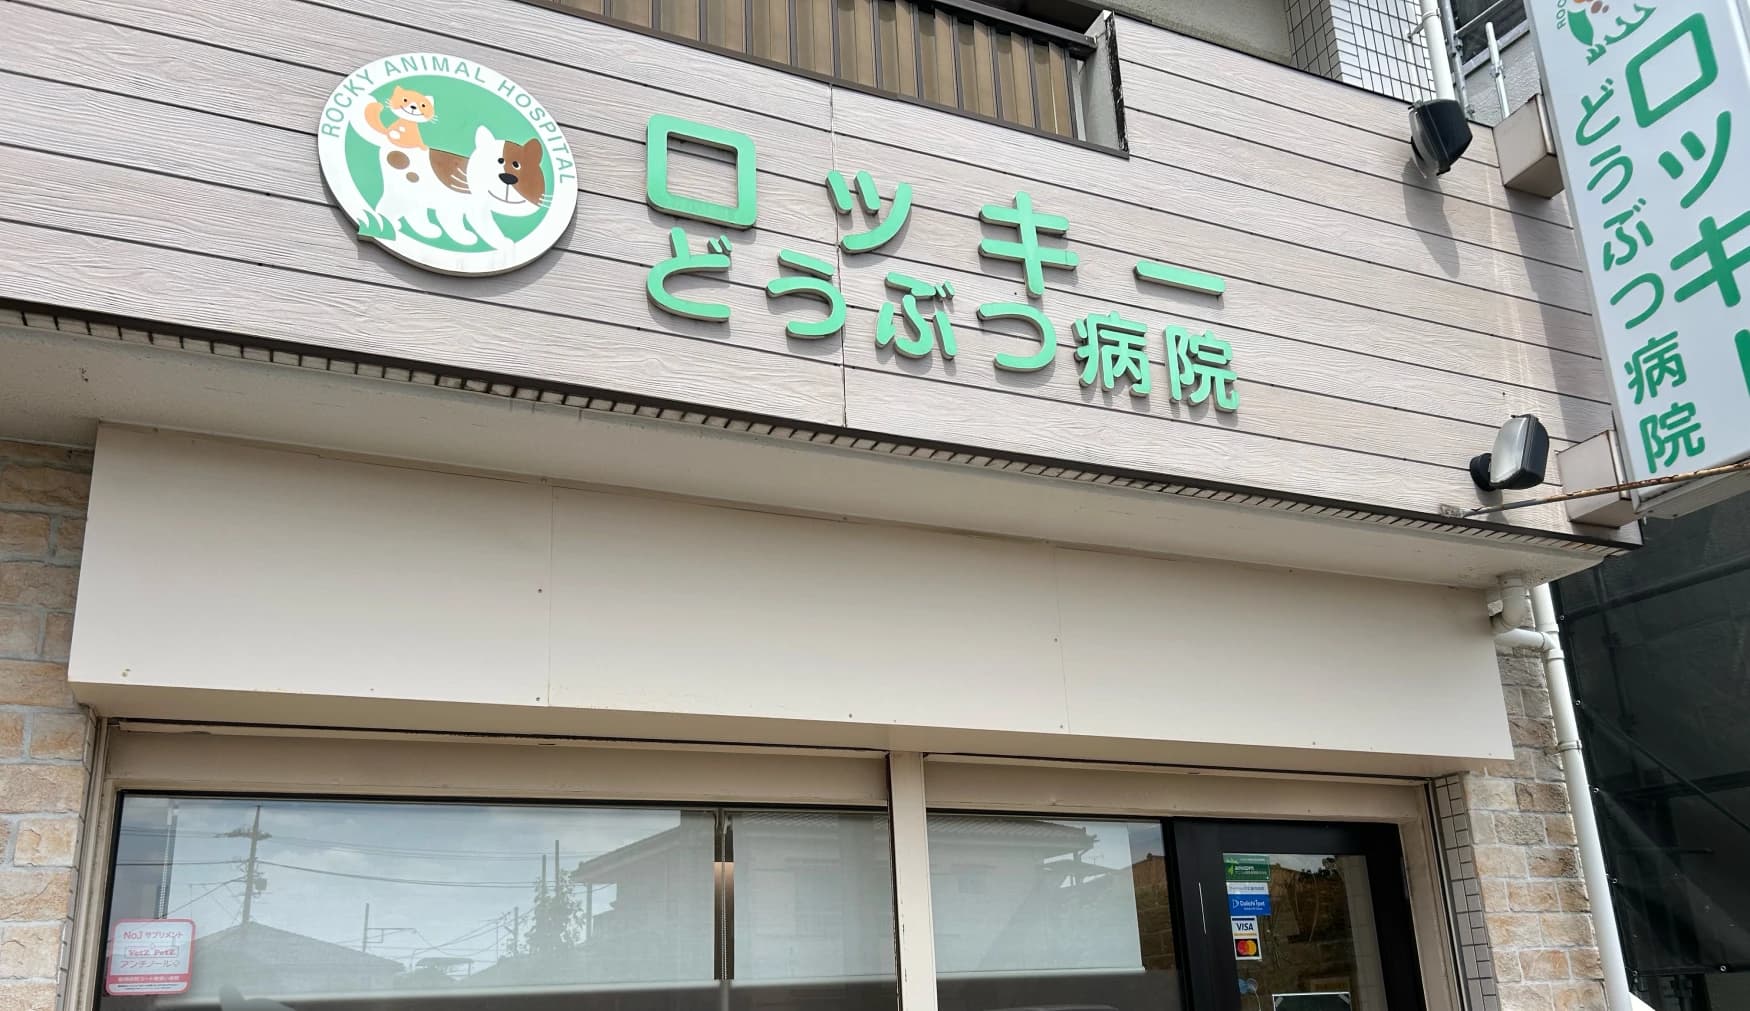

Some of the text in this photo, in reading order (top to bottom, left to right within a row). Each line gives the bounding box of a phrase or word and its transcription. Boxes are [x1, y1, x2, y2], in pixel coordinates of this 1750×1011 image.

[321, 55, 575, 184] ROCKY ANIMAL HOSPITAL
[646, 113, 1226, 297] ロッキー
[1576, 78, 1706, 474] どうぶつ病院
[646, 227, 1240, 412] どうぶつ病院
[145, 931, 184, 939] サプリメント
[1236, 922, 1254, 931] VISA
